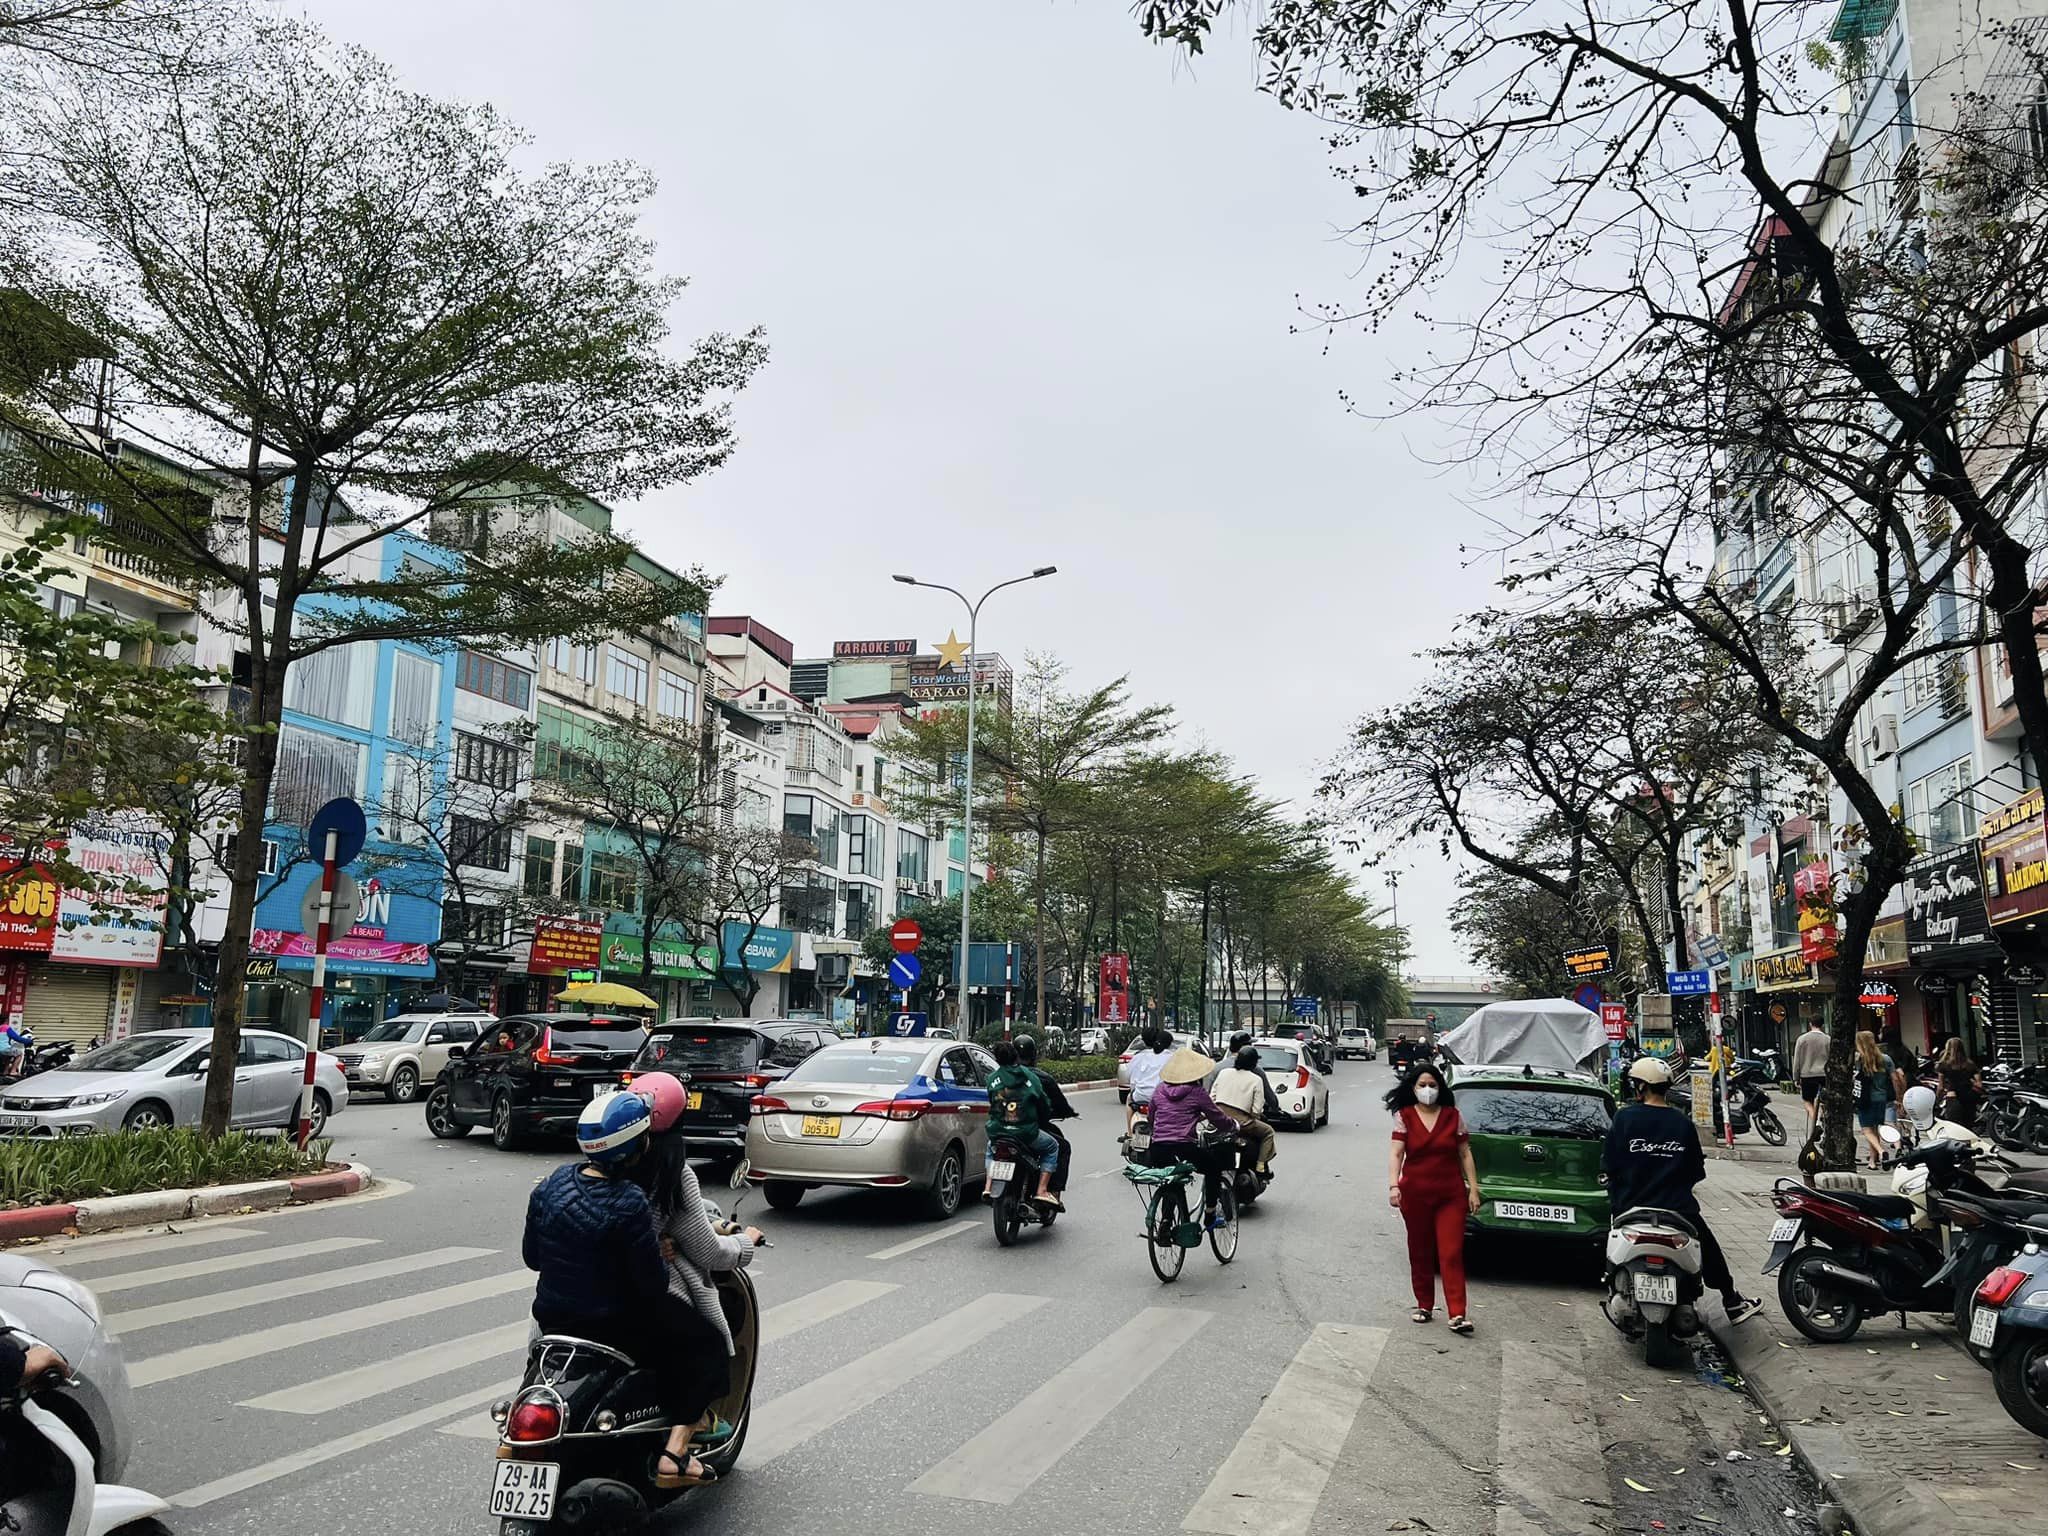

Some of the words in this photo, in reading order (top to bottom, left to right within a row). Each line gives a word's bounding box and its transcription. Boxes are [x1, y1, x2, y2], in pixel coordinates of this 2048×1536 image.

[836, 642, 890, 654] KARAOKE
[894, 641, 912, 652] 107
[1502, 1203, 1569, 1220] 30G-888.89
[502, 1464, 548, 1490] 29-AA
[494, 1489, 551, 1516] 092.25
